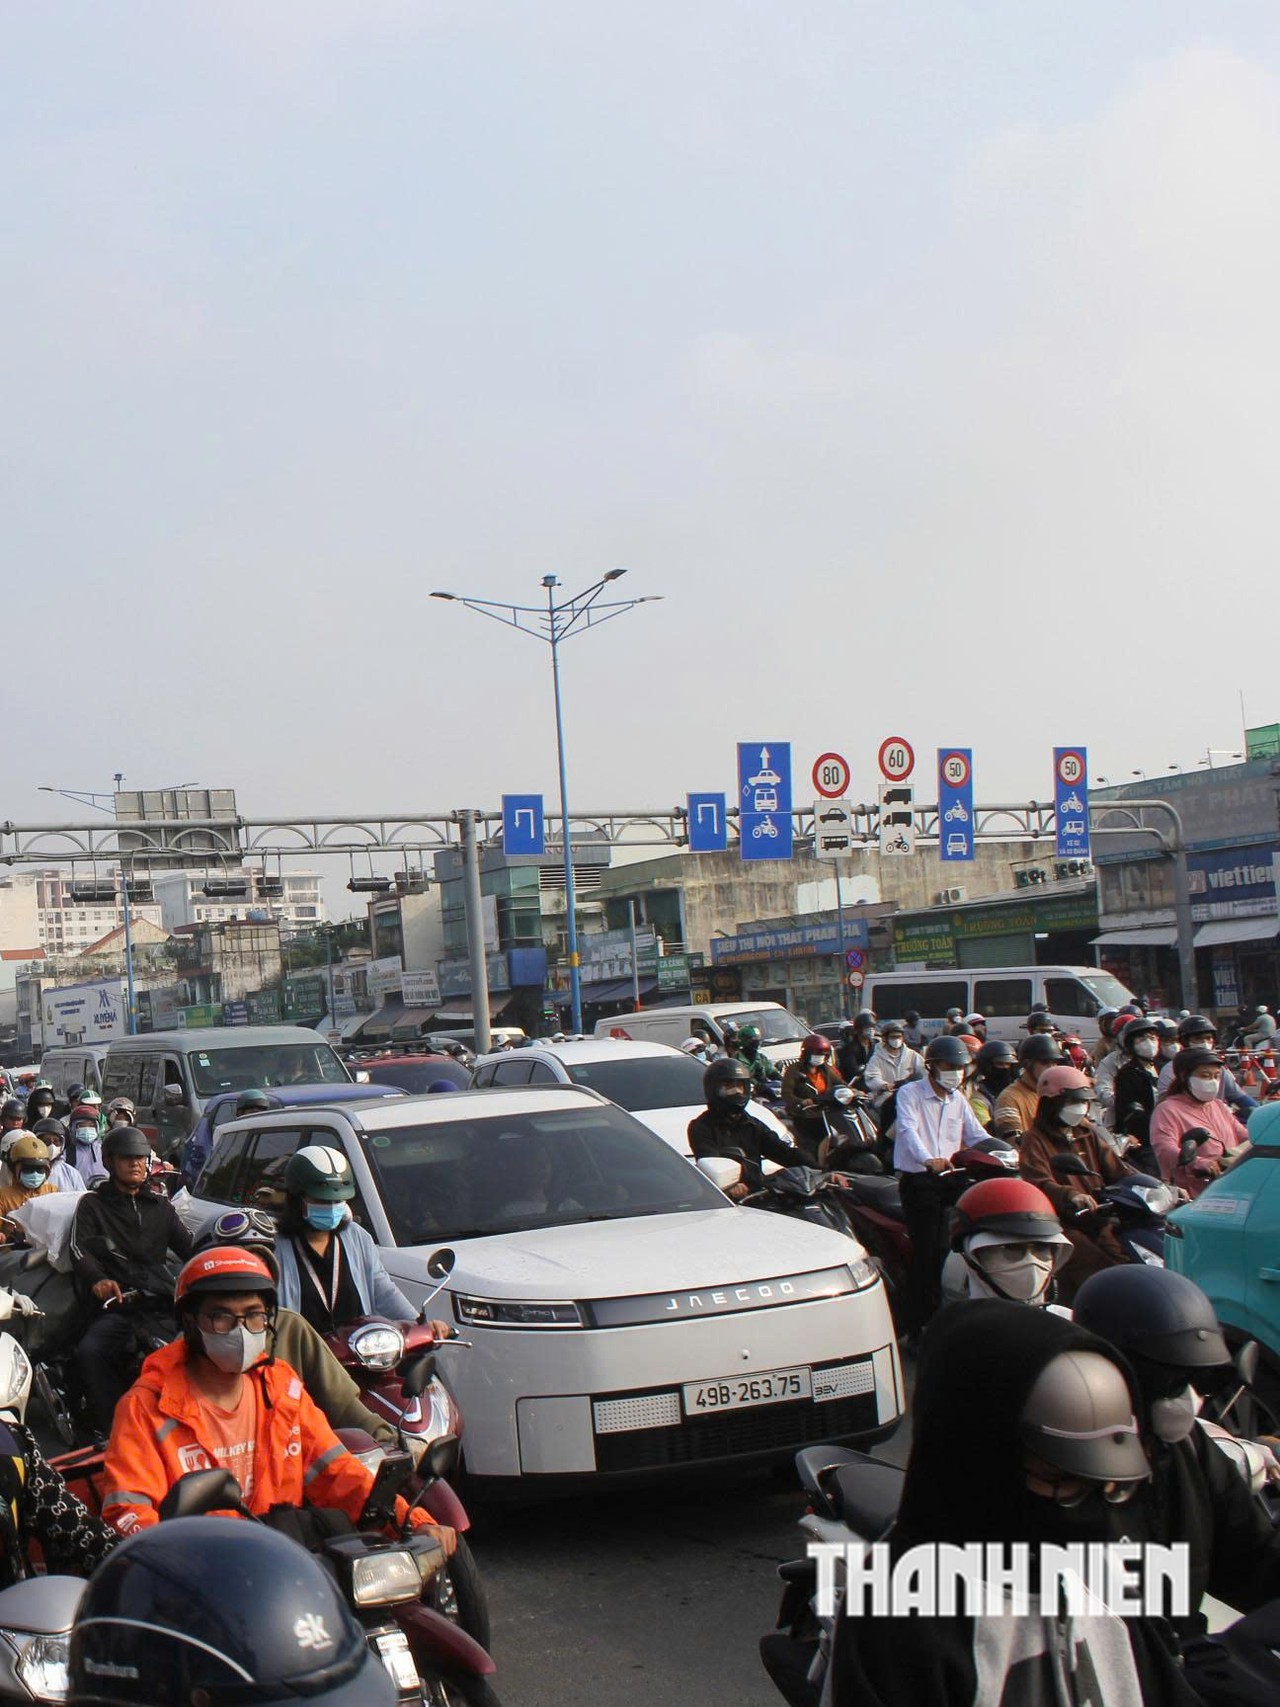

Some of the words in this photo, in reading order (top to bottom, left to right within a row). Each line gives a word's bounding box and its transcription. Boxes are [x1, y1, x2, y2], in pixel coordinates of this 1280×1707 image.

[888, 749, 905, 768] 60
[822, 766, 840, 786] 80
[949, 762, 962, 778] 50
[1064, 761, 1077, 776] 50
[666, 1281, 795, 1310] JAECOO
[695, 1374, 801, 1408] 49B-263.75
